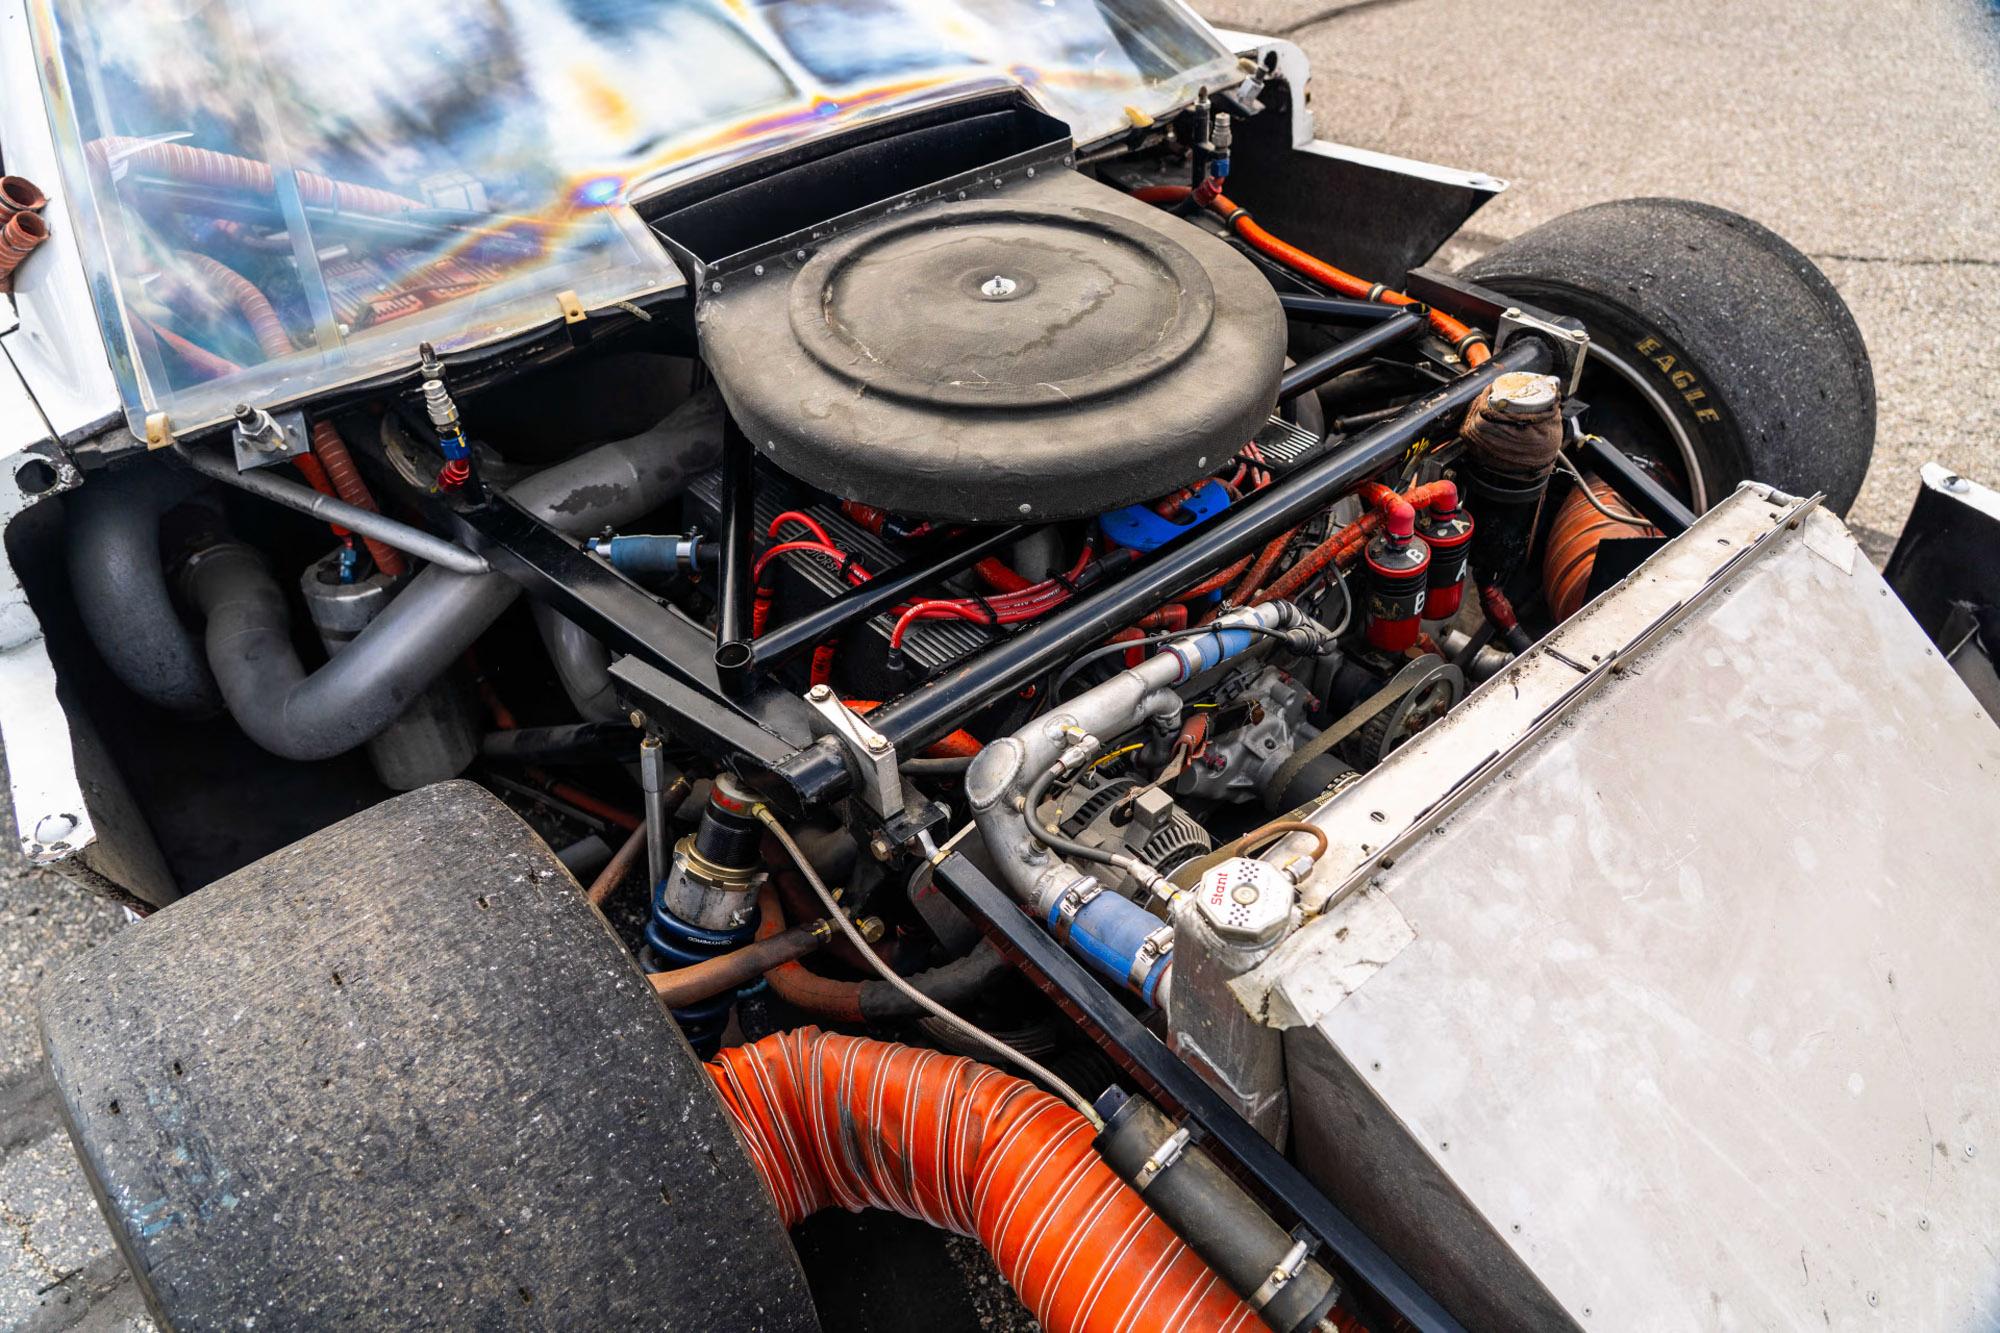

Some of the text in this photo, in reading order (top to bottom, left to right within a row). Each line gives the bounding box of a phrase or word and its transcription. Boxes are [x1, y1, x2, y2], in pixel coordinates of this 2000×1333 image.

[1636, 336, 1720, 423] EAGLE
[1451, 519, 1471, 534] A
[1406, 548, 1424, 564] B
[1455, 558, 1468, 582] A
[1414, 590, 1426, 616] B
[1211, 872, 1228, 906] Stant
